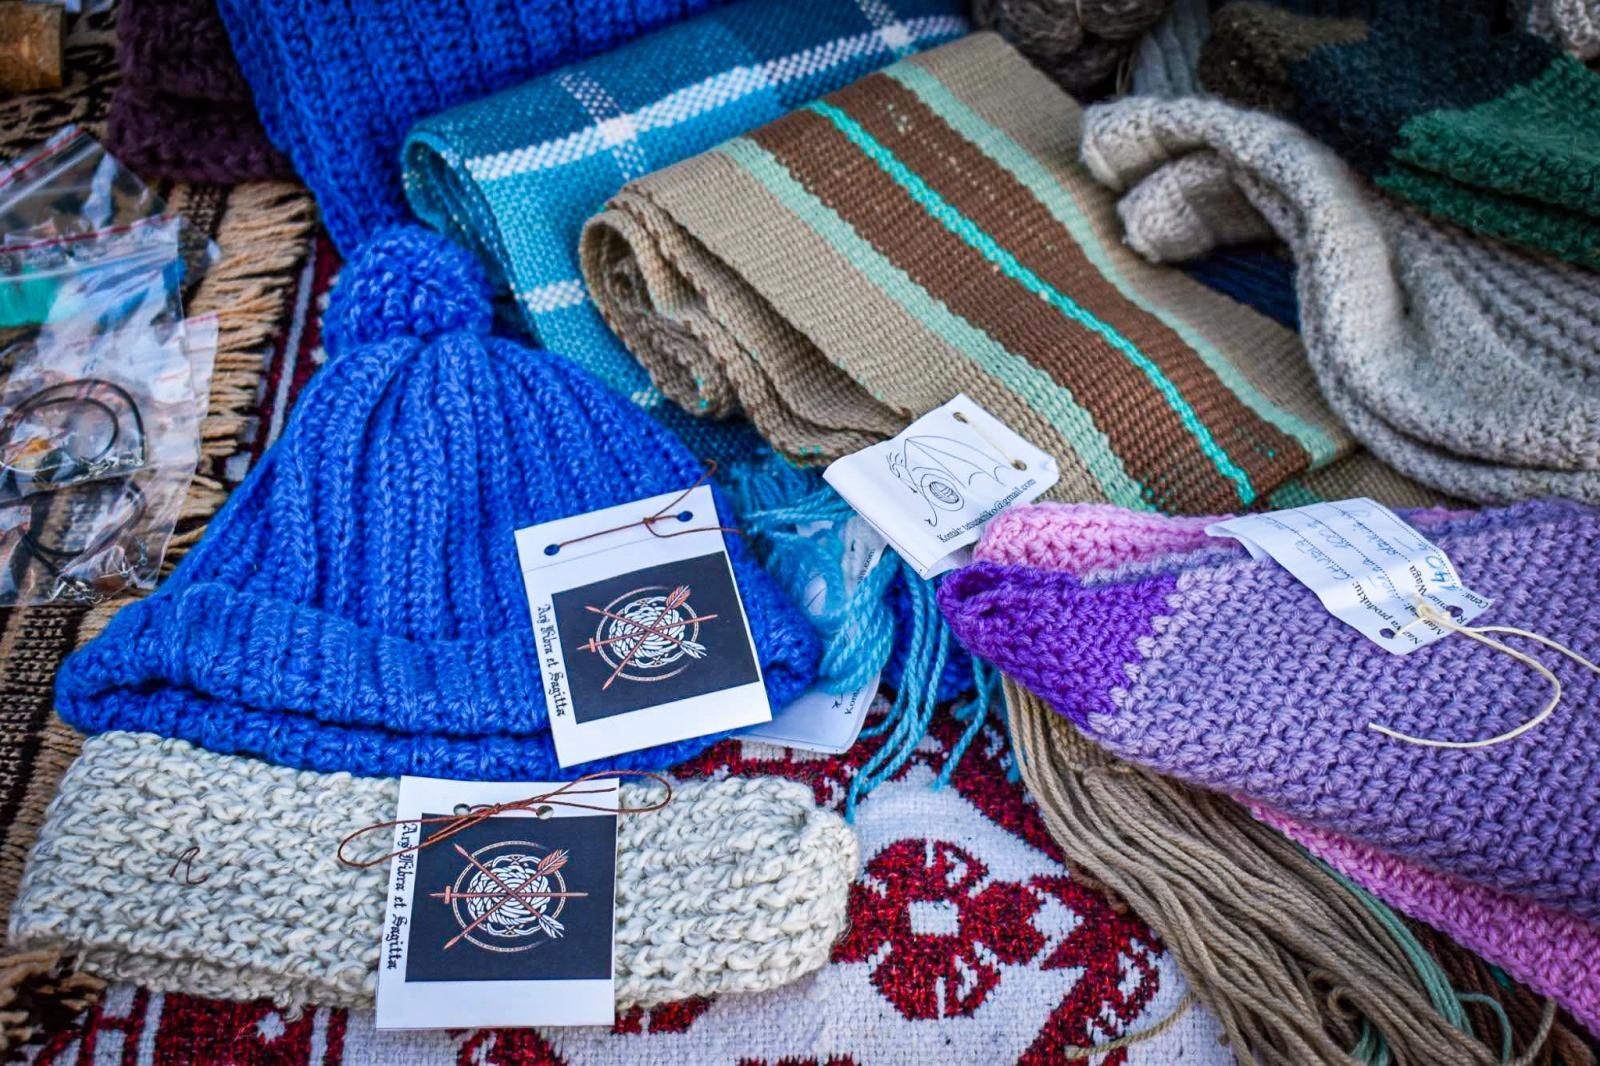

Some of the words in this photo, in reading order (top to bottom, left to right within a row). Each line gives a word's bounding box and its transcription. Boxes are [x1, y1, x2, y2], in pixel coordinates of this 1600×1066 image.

[1351, 580, 1393, 621] produktu:
[1461, 591, 1489, 609] Cena:
[547, 658, 559, 668] et
[548, 672, 568, 717] Sagitta
[394, 896, 407, 909] et
[385, 914, 408, 970] Sagitta
